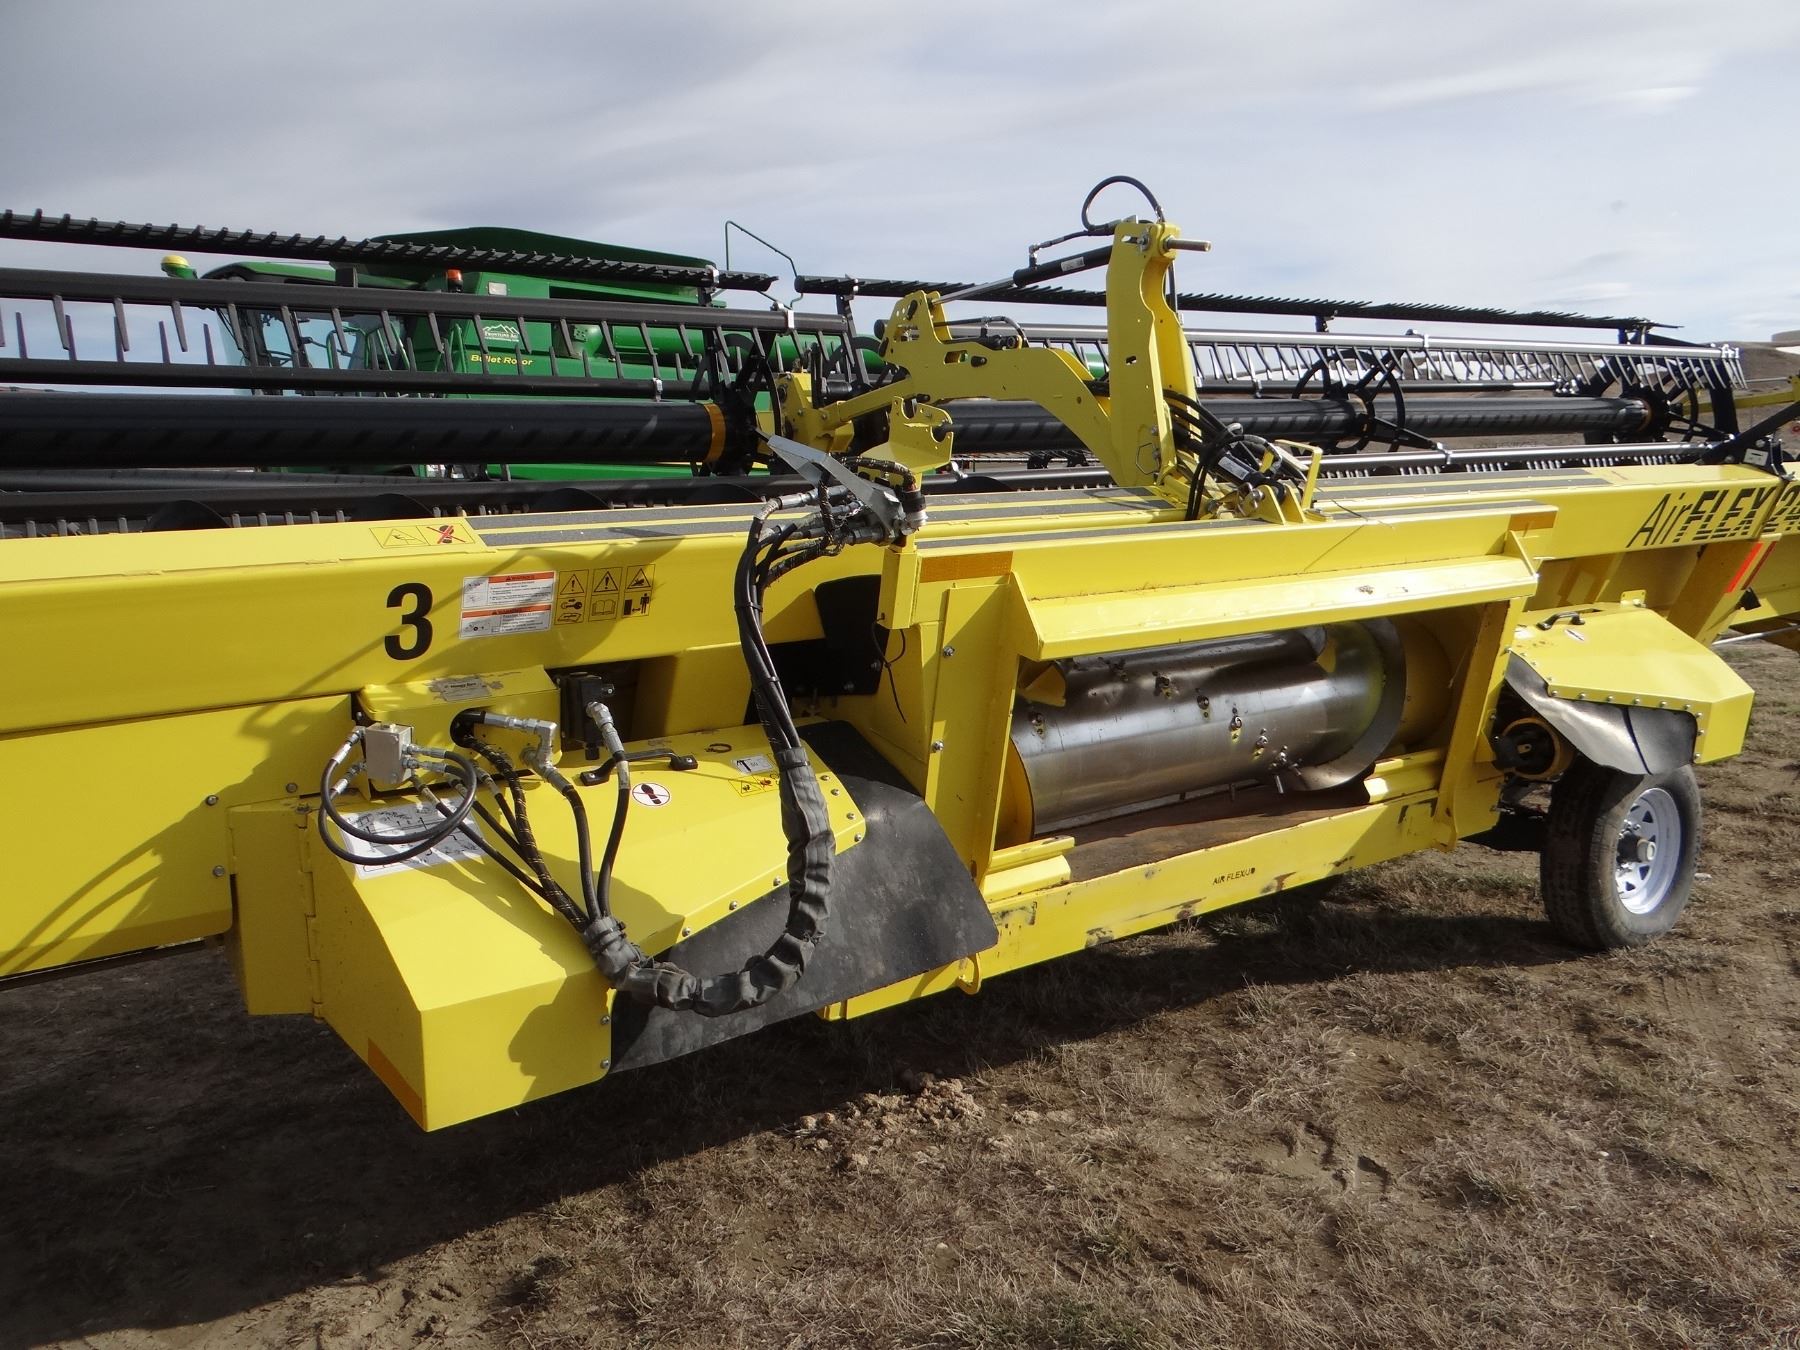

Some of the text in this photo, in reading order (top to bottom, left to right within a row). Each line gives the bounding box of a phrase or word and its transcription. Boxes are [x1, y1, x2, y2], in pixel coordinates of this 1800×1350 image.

[503, 357, 533, 365] Roor
[384, 582, 433, 661] 3
[1213, 875, 1225, 885] AIR
